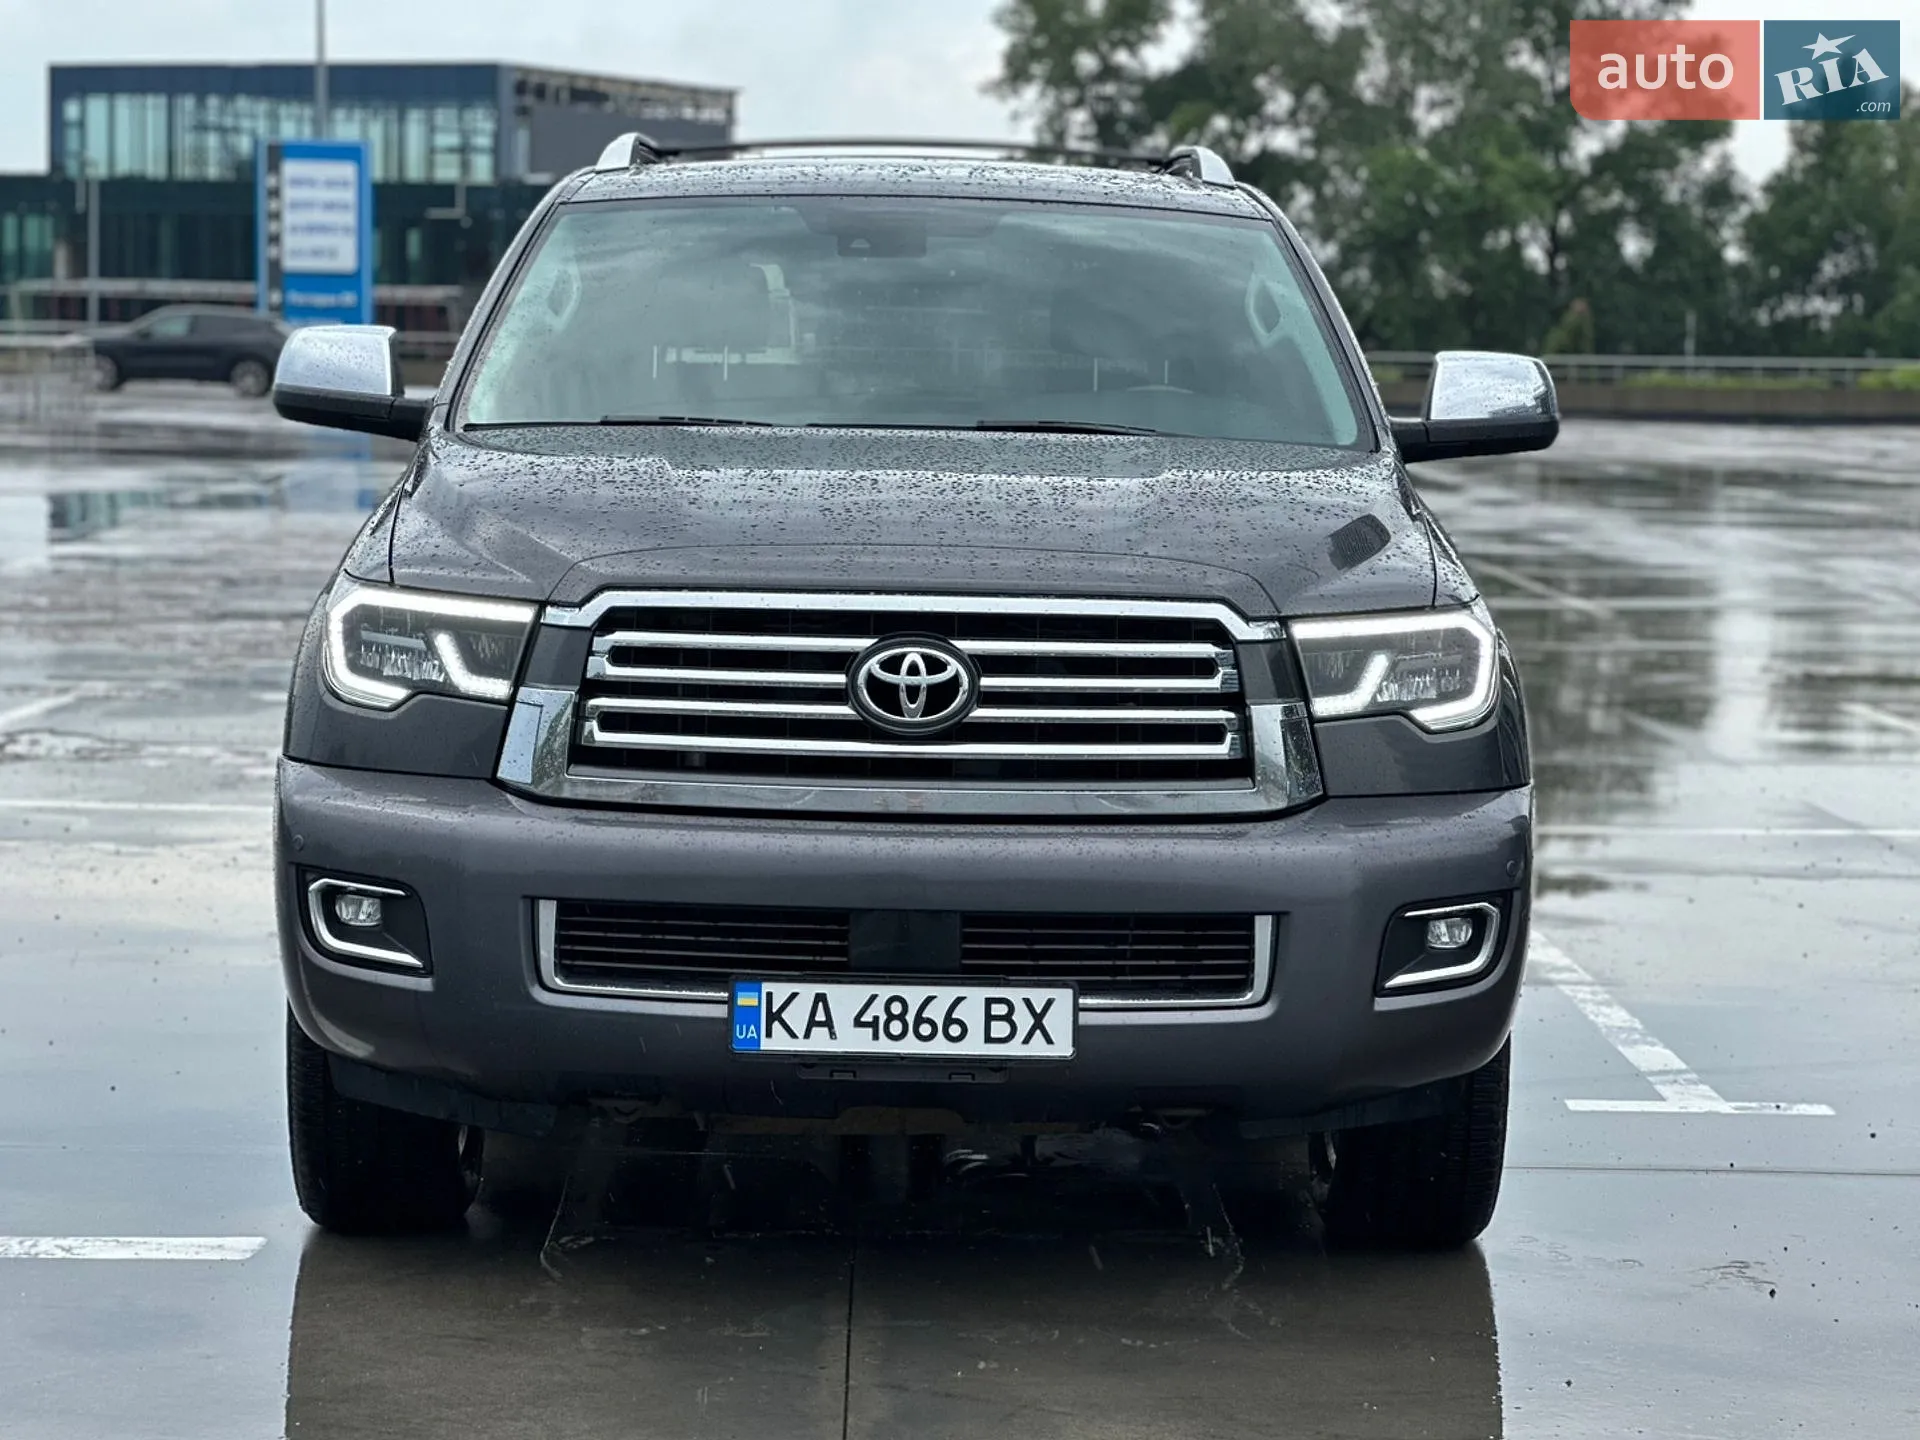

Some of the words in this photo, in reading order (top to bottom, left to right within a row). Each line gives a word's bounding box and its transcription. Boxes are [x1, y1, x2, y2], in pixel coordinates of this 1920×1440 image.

[735, 1023, 758, 1040] UA
[765, 991, 838, 1040] KA
[853, 993, 968, 1043] 4866
[983, 997, 1056, 1045] BX
